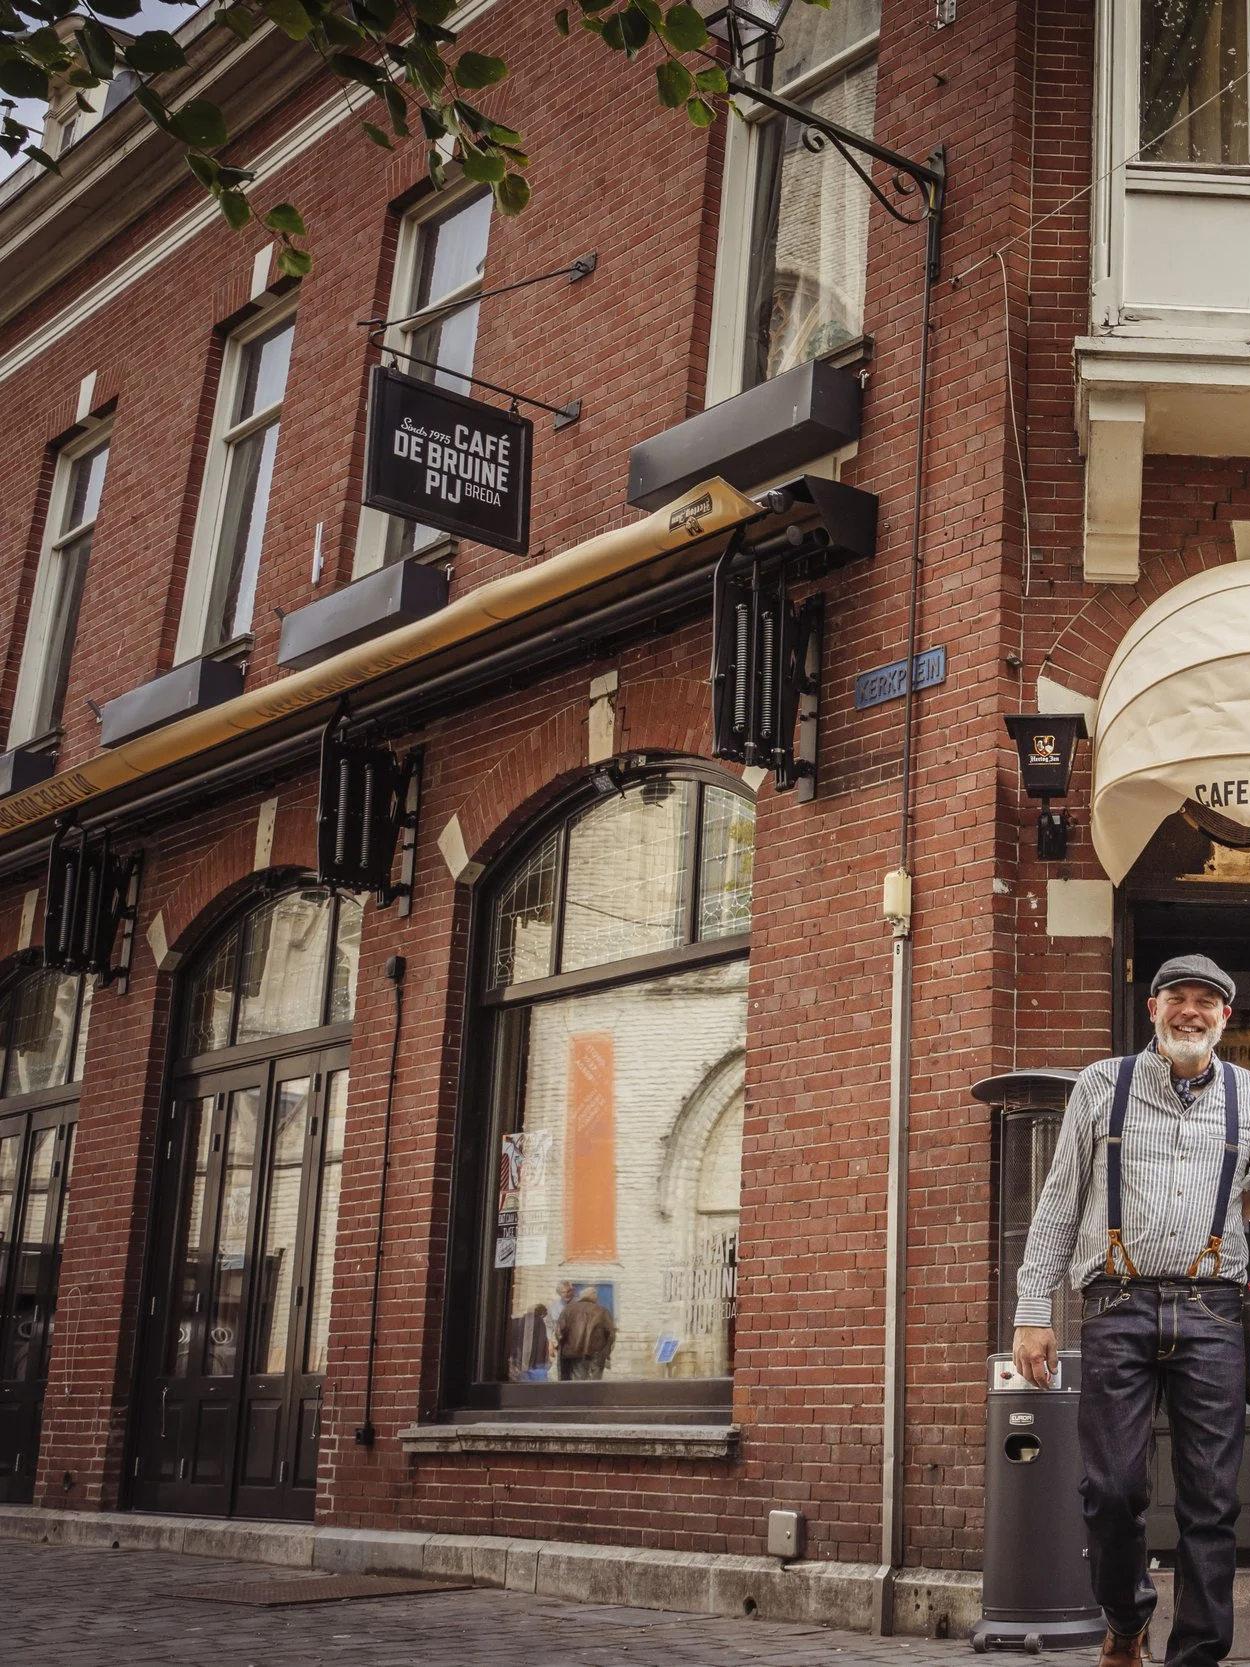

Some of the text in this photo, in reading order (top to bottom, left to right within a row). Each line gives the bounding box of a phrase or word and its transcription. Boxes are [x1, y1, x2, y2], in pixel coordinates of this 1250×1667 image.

[393, 429, 510, 493] DE BRUINE
[400, 416, 511, 466] Sinds 1975 CAFÉ
[425, 468, 501, 507] PIJ BREDA
[860, 655, 940, 702] KERKPEIN
[1195, 779, 1249, 808] CAFE
